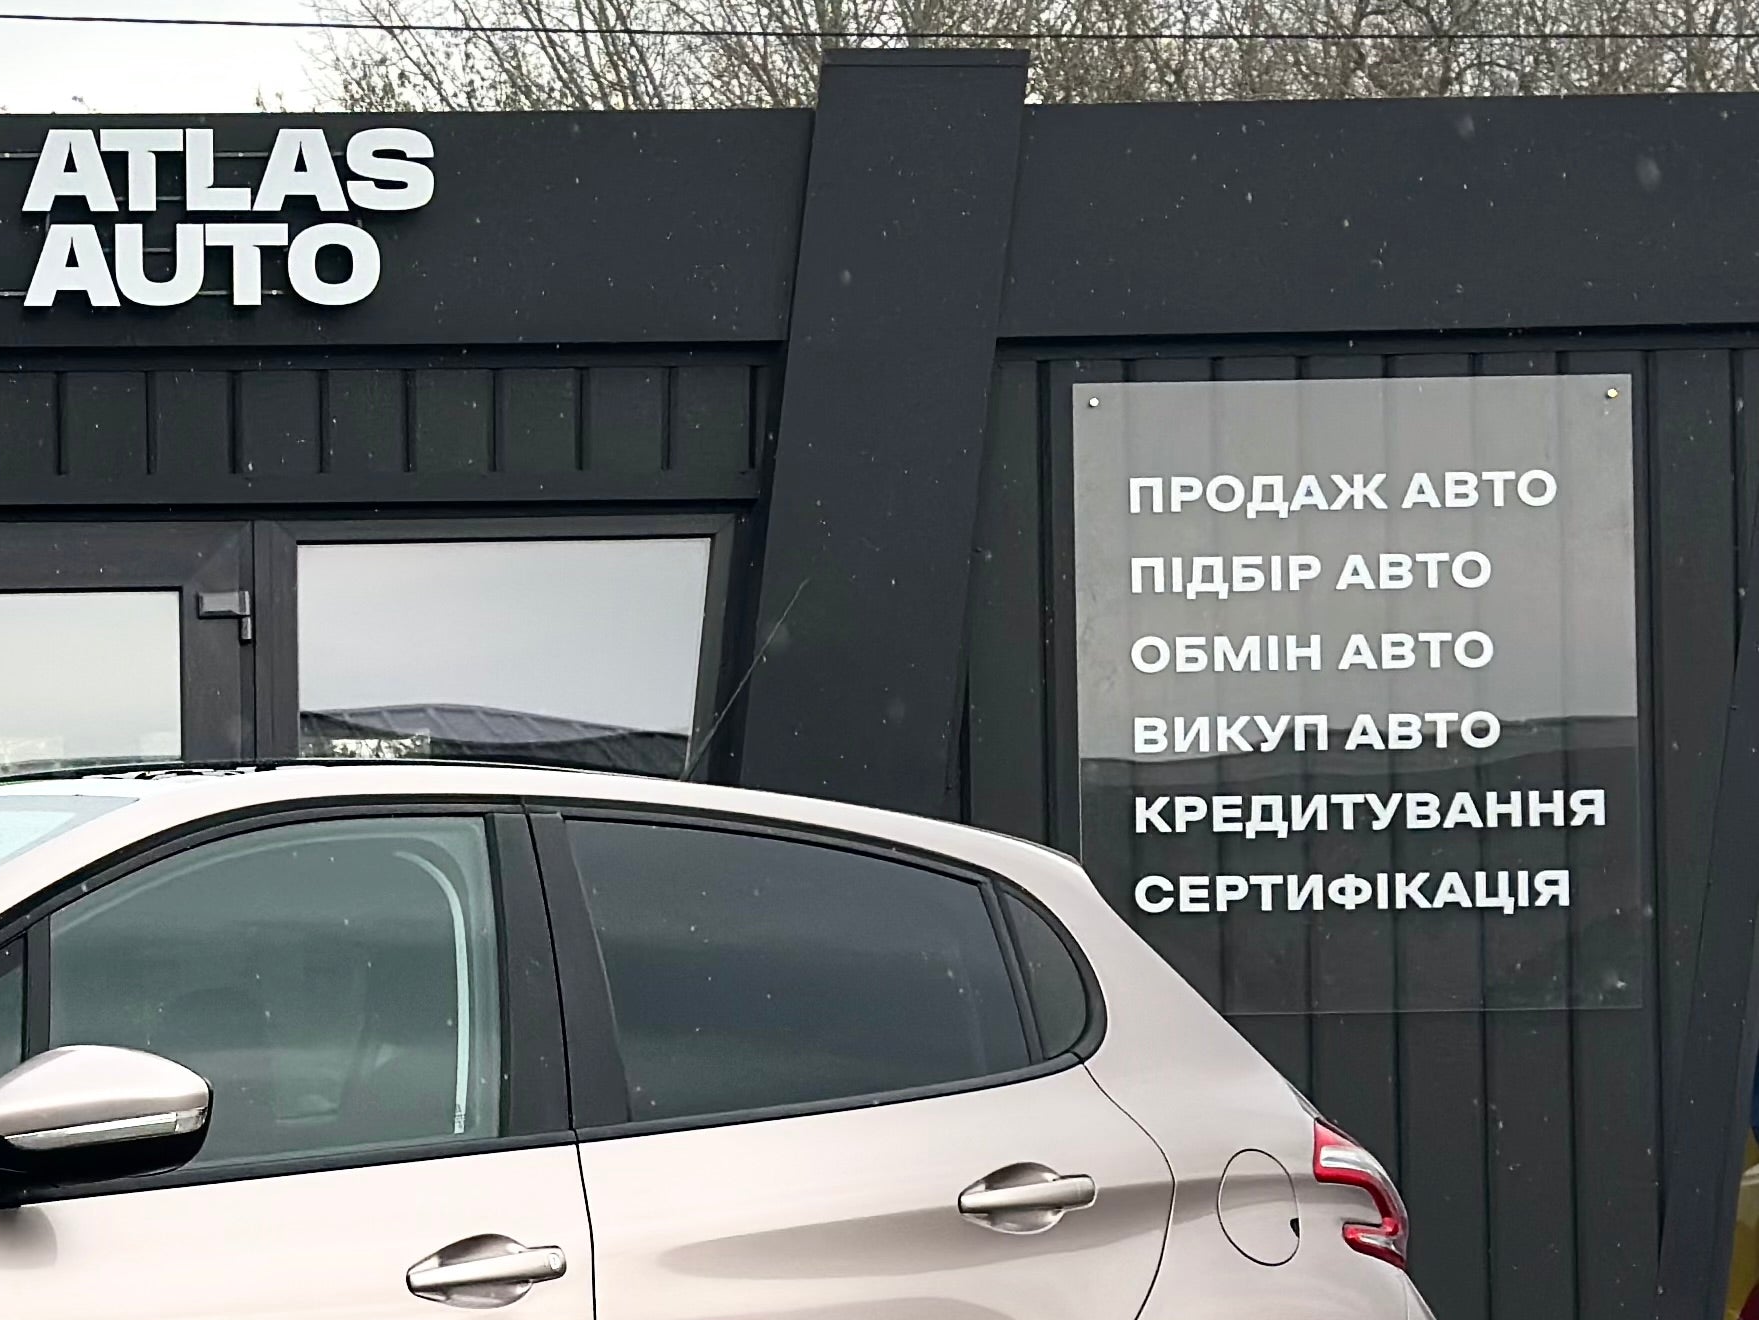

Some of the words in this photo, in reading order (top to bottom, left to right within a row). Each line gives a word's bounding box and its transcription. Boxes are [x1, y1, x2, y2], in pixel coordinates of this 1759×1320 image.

[21, 127, 435, 212] ATLAS
[24, 223, 381, 307] AUTO
[1129, 473, 1388, 519] ПРОДАЖ
[1402, 470, 1558, 509] АВТО
[1131, 555, 1322, 600] ПІДБІР
[1336, 551, 1492, 590] АВТО
[1131, 635, 1321, 674] ОБМІН
[1338, 631, 1494, 670] АВТО
[1135, 715, 1328, 753] ВИКУП
[1345, 711, 1501, 750] АВТО
[1136, 789, 1606, 839] КРЕДИТУВАННЯ
[1135, 870, 1570, 915] СЕРТИФІКАЦІЯ
